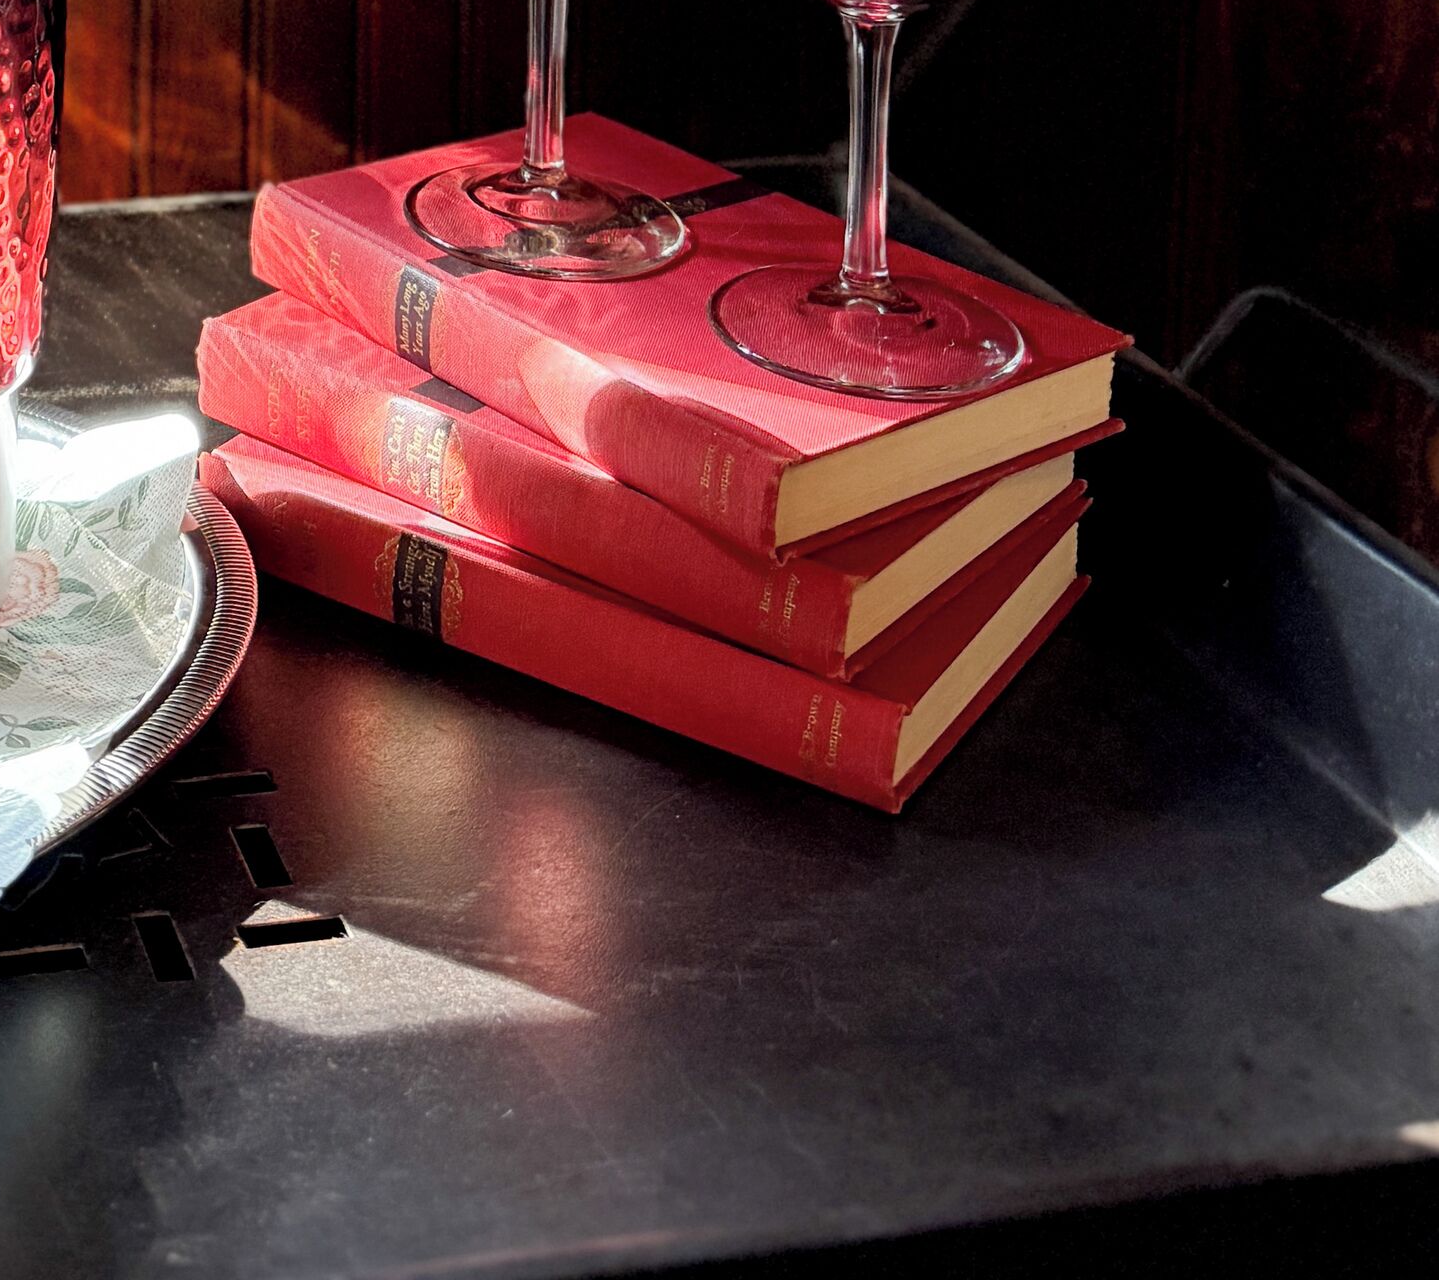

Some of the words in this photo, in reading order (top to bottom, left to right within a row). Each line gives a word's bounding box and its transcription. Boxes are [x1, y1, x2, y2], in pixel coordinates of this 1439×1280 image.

[400, 281, 417, 314] Long
[412, 290, 430, 320] Ago
[400, 315, 413, 354] Many
[412, 320, 424, 357] Years
[406, 425, 425, 463] There
[426, 427, 446, 464] Here
[386, 460, 400, 484] You
[406, 471, 420, 495] Get
[425, 466, 440, 505] From
[417, 545, 443, 598] Myself
[417, 601, 432, 634] Here
[781, 572, 800, 637] ompany
[824, 700, 847, 768] Company
